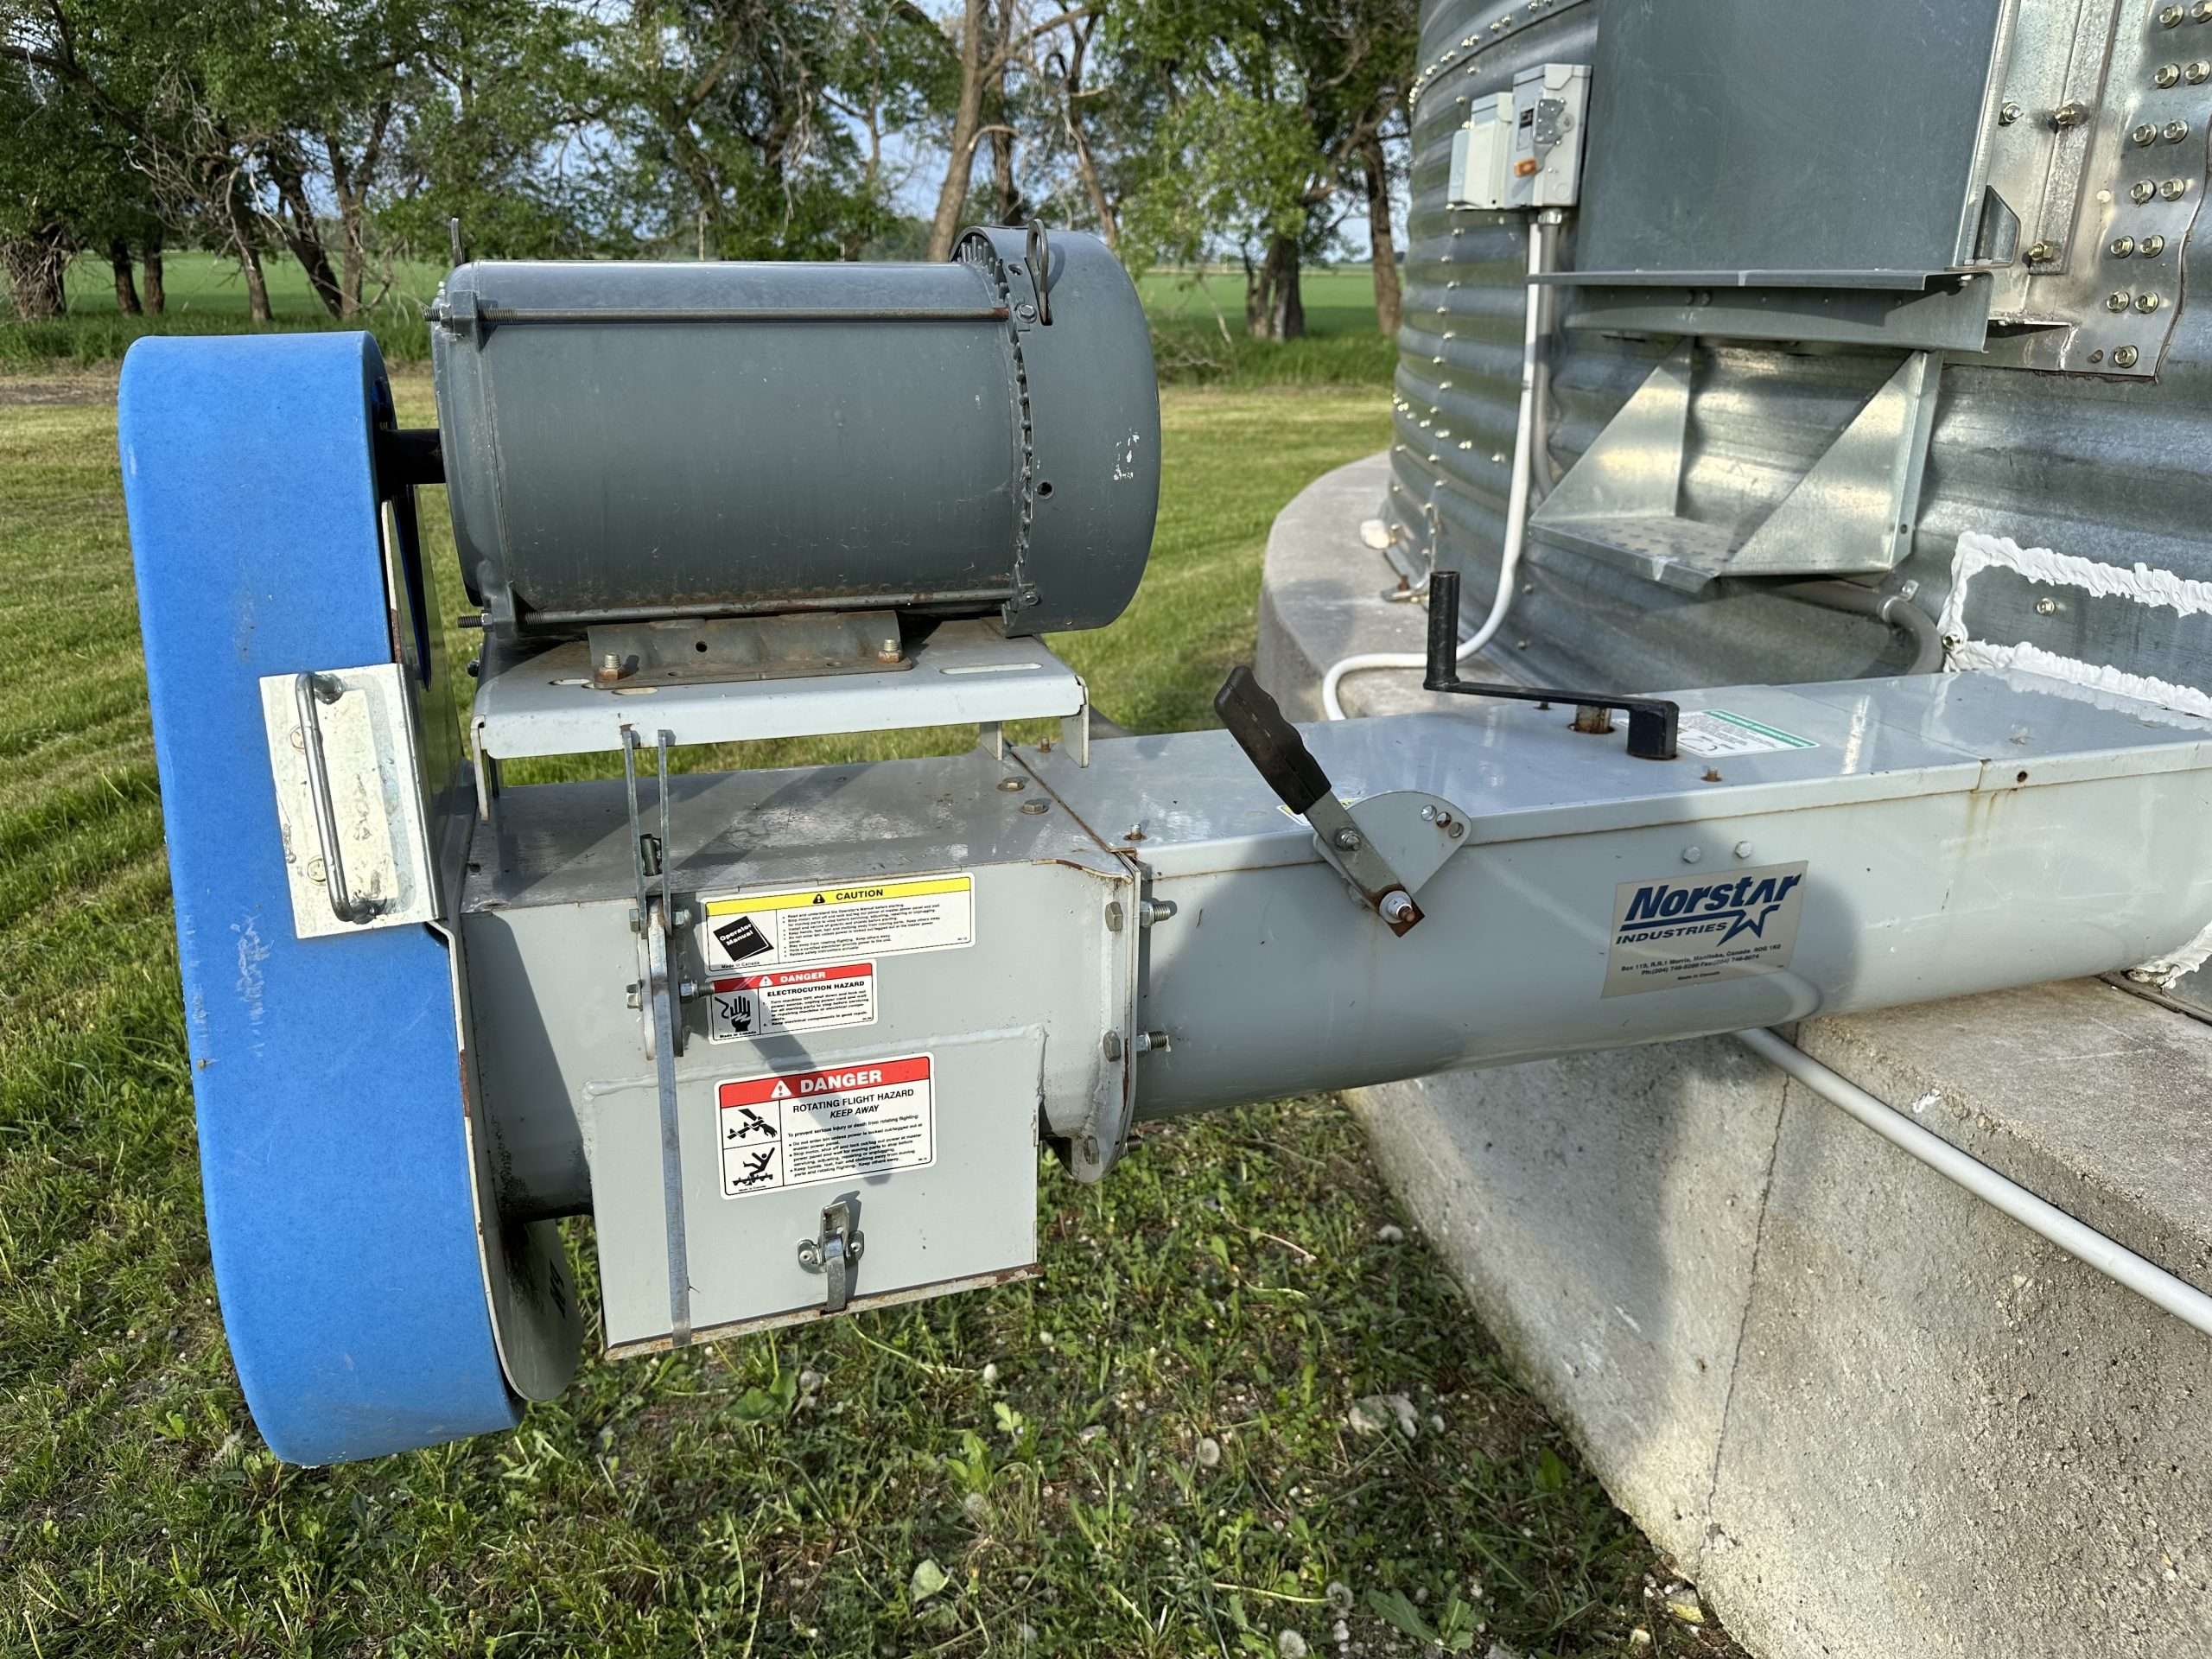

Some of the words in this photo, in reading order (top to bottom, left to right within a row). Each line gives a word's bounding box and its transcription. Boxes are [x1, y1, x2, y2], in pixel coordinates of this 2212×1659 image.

[836, 888, 884, 900] CAUTION
[719, 924, 752, 941] Operator
[726, 930, 753, 946] Manual
[1616, 922, 1727, 944] INDUSTRIES
[780, 971, 826, 983] DANGER
[767, 984, 832, 997] ELECTROCUTION
[834, 980, 865, 989] HAZARD
[800, 1068, 882, 1094] DANGER
[792, 1099, 840, 1113] ROTATING
[842, 1094, 875, 1106] FLIGHT
[877, 1089, 914, 1101] HAZARD
[830, 1109, 853, 1119] KEEP
[855, 1104, 880, 1116] AWAY
